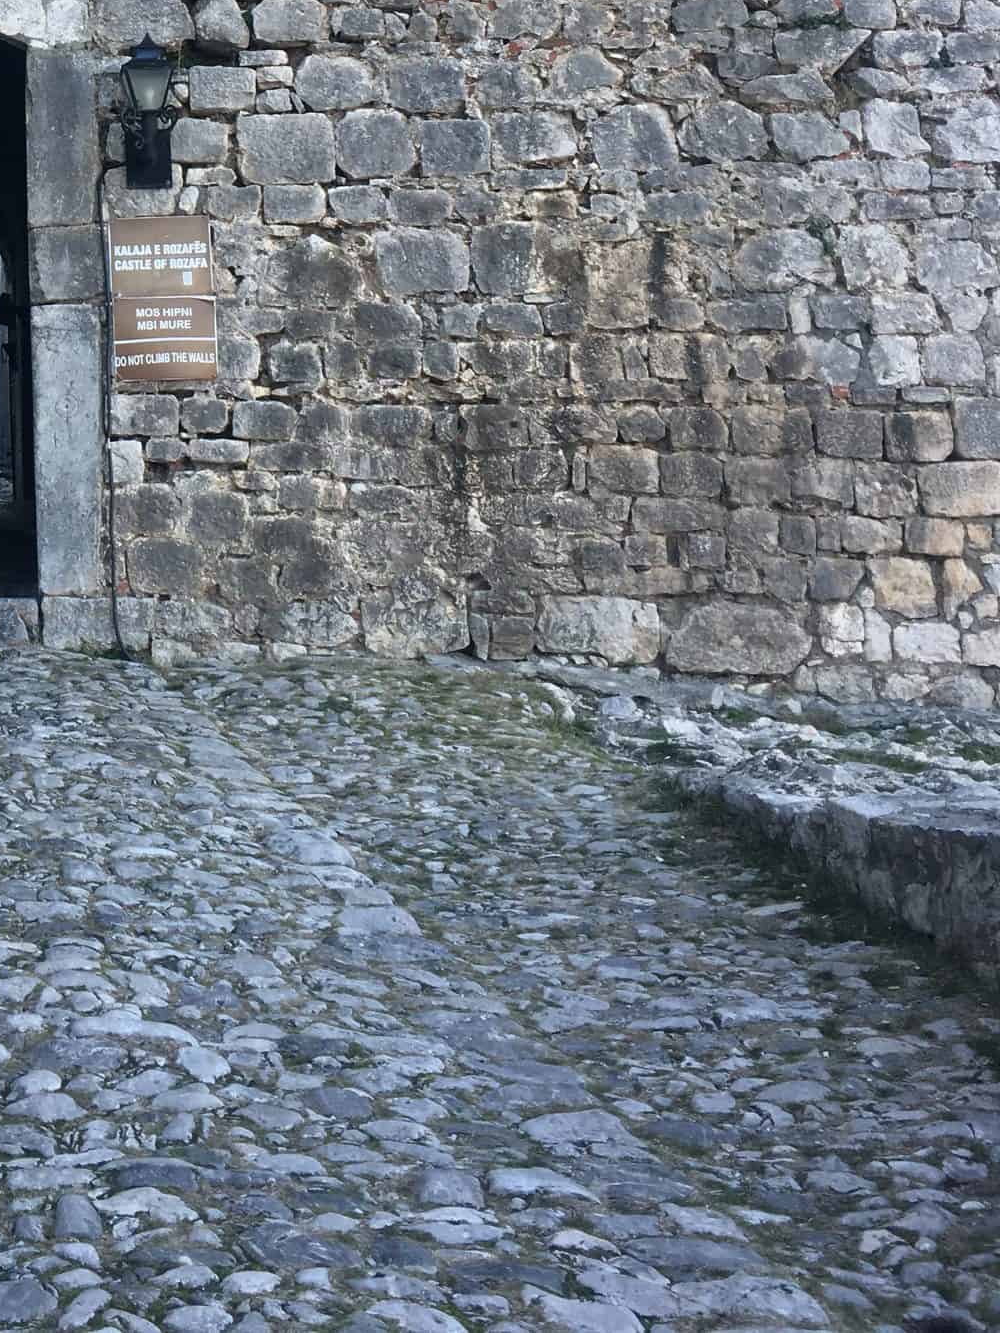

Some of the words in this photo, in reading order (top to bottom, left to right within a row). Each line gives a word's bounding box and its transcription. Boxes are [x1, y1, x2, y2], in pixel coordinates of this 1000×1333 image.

[114, 244, 152, 256] KALAJA
[154, 244, 161, 254] E
[163, 240, 207, 254] ROZAFËS
[115, 259, 152, 271] CASTLE
[154, 259, 167, 269] OF
[170, 258, 208, 268] ROZAFA
[136, 308, 160, 317] MOS
[163, 307, 192, 316] HIPNI
[137, 321, 157, 330] MBI
[160, 320, 192, 329] MURE
[115, 357, 126, 367] DO
[128, 354, 144, 366] NOT
[146, 352, 170, 364] CLIMB
[172, 352, 188, 362] THE
[188, 352, 214, 364] WALLS
